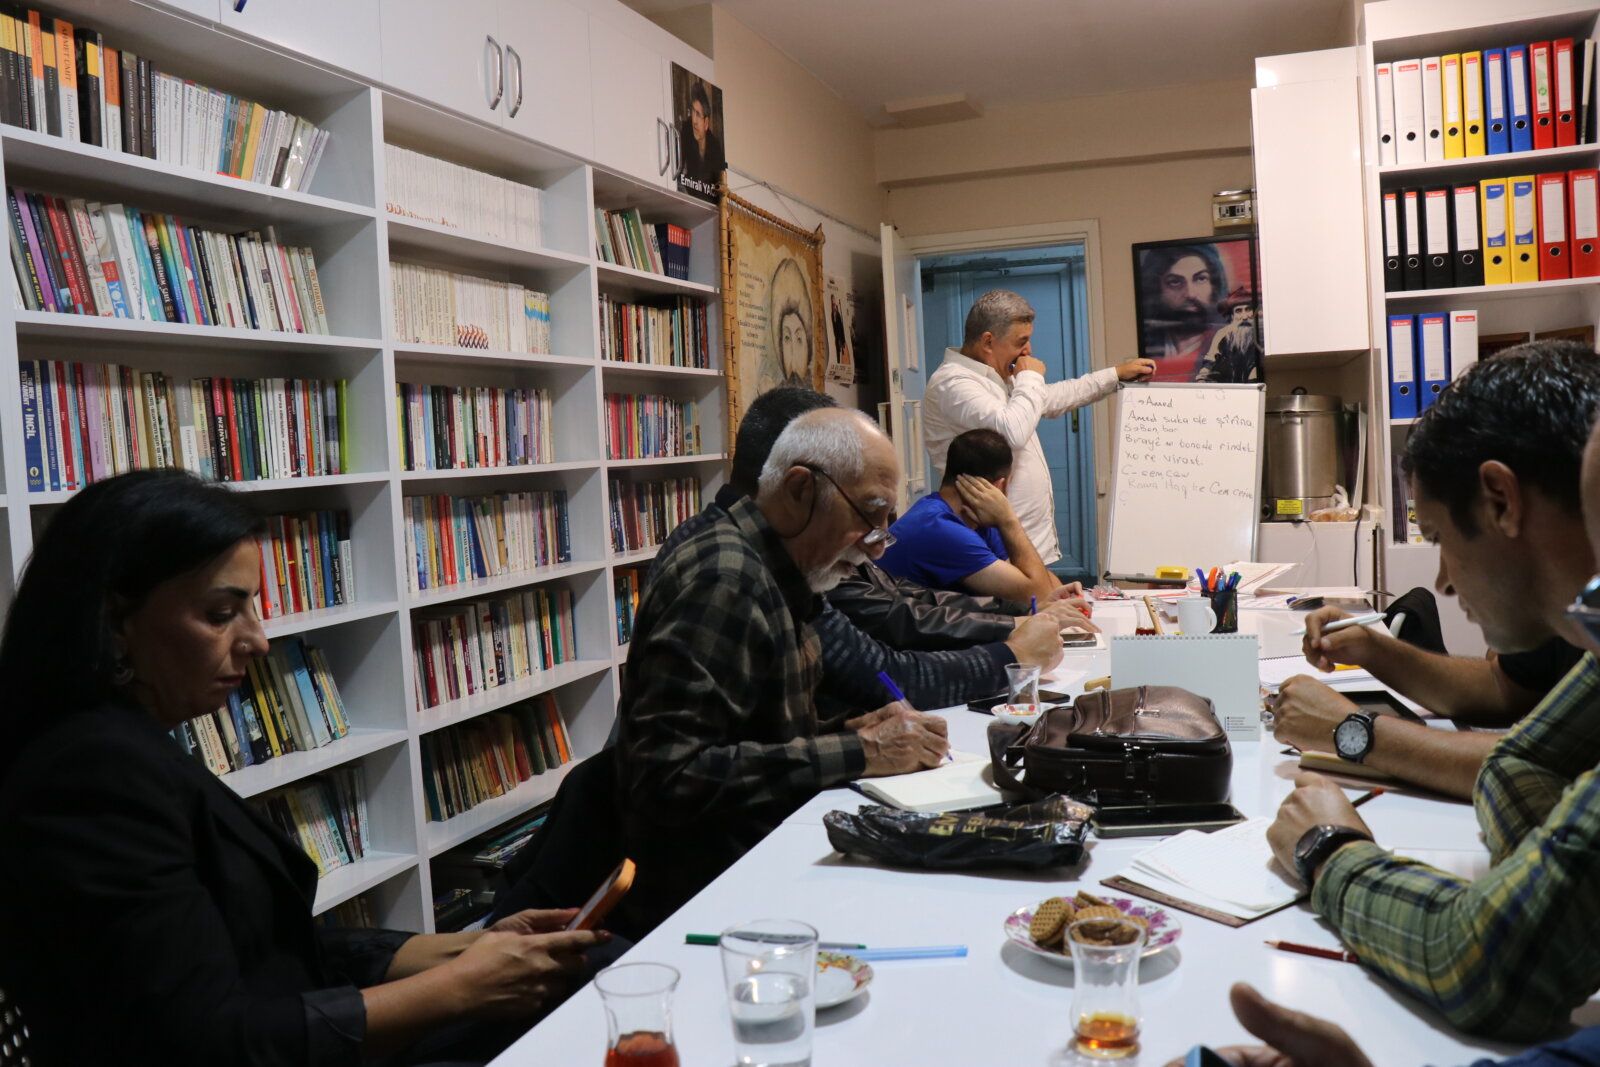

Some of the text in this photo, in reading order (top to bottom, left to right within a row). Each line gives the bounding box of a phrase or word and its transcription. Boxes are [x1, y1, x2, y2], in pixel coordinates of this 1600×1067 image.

[680, 173, 703, 192] Emirali
[108, 282, 123, 309] YOL
[21, 370, 30, 406] TESTAMENT
[1145, 395, 1174, 408] Amed
[1128, 409, 1158, 423] Amed
[218, 416, 227, 457] SATANİZM
